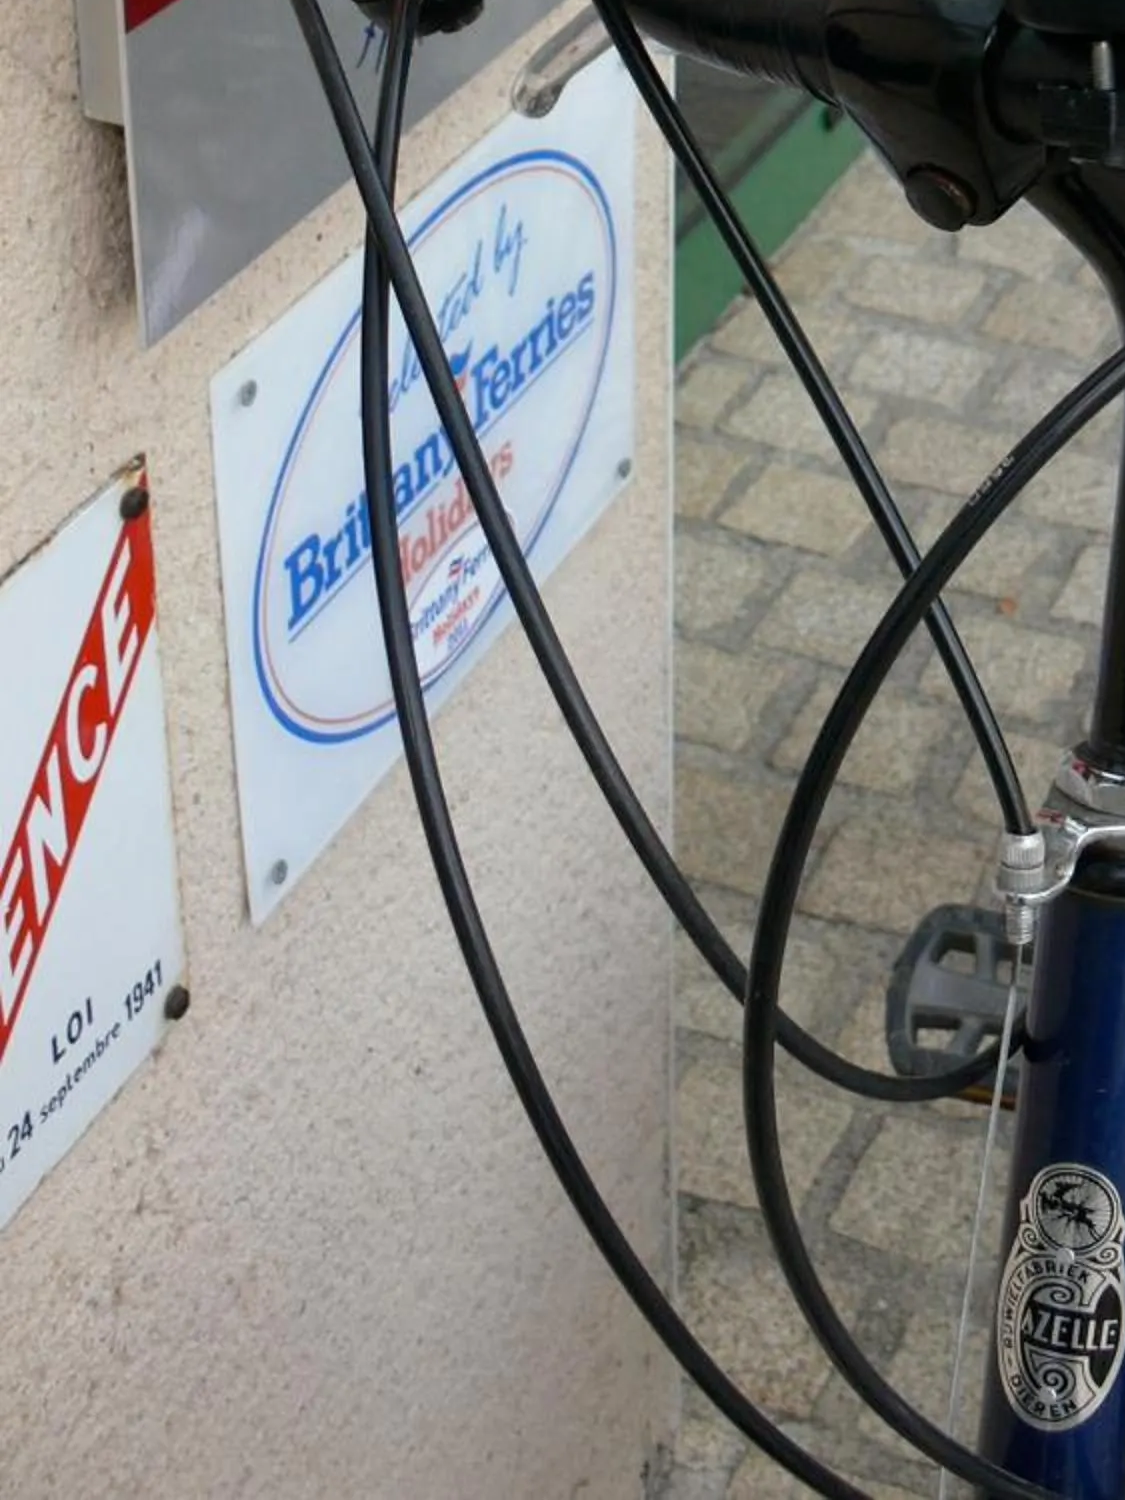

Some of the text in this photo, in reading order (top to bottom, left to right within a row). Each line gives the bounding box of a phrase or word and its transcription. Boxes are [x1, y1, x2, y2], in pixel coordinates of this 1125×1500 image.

[471, 269, 594, 430] Ferries
[0, 545, 139, 1028] ENCE
[8, 959, 163, 1159] 24 septembre 1941
[51, 996, 94, 1064] LOI
